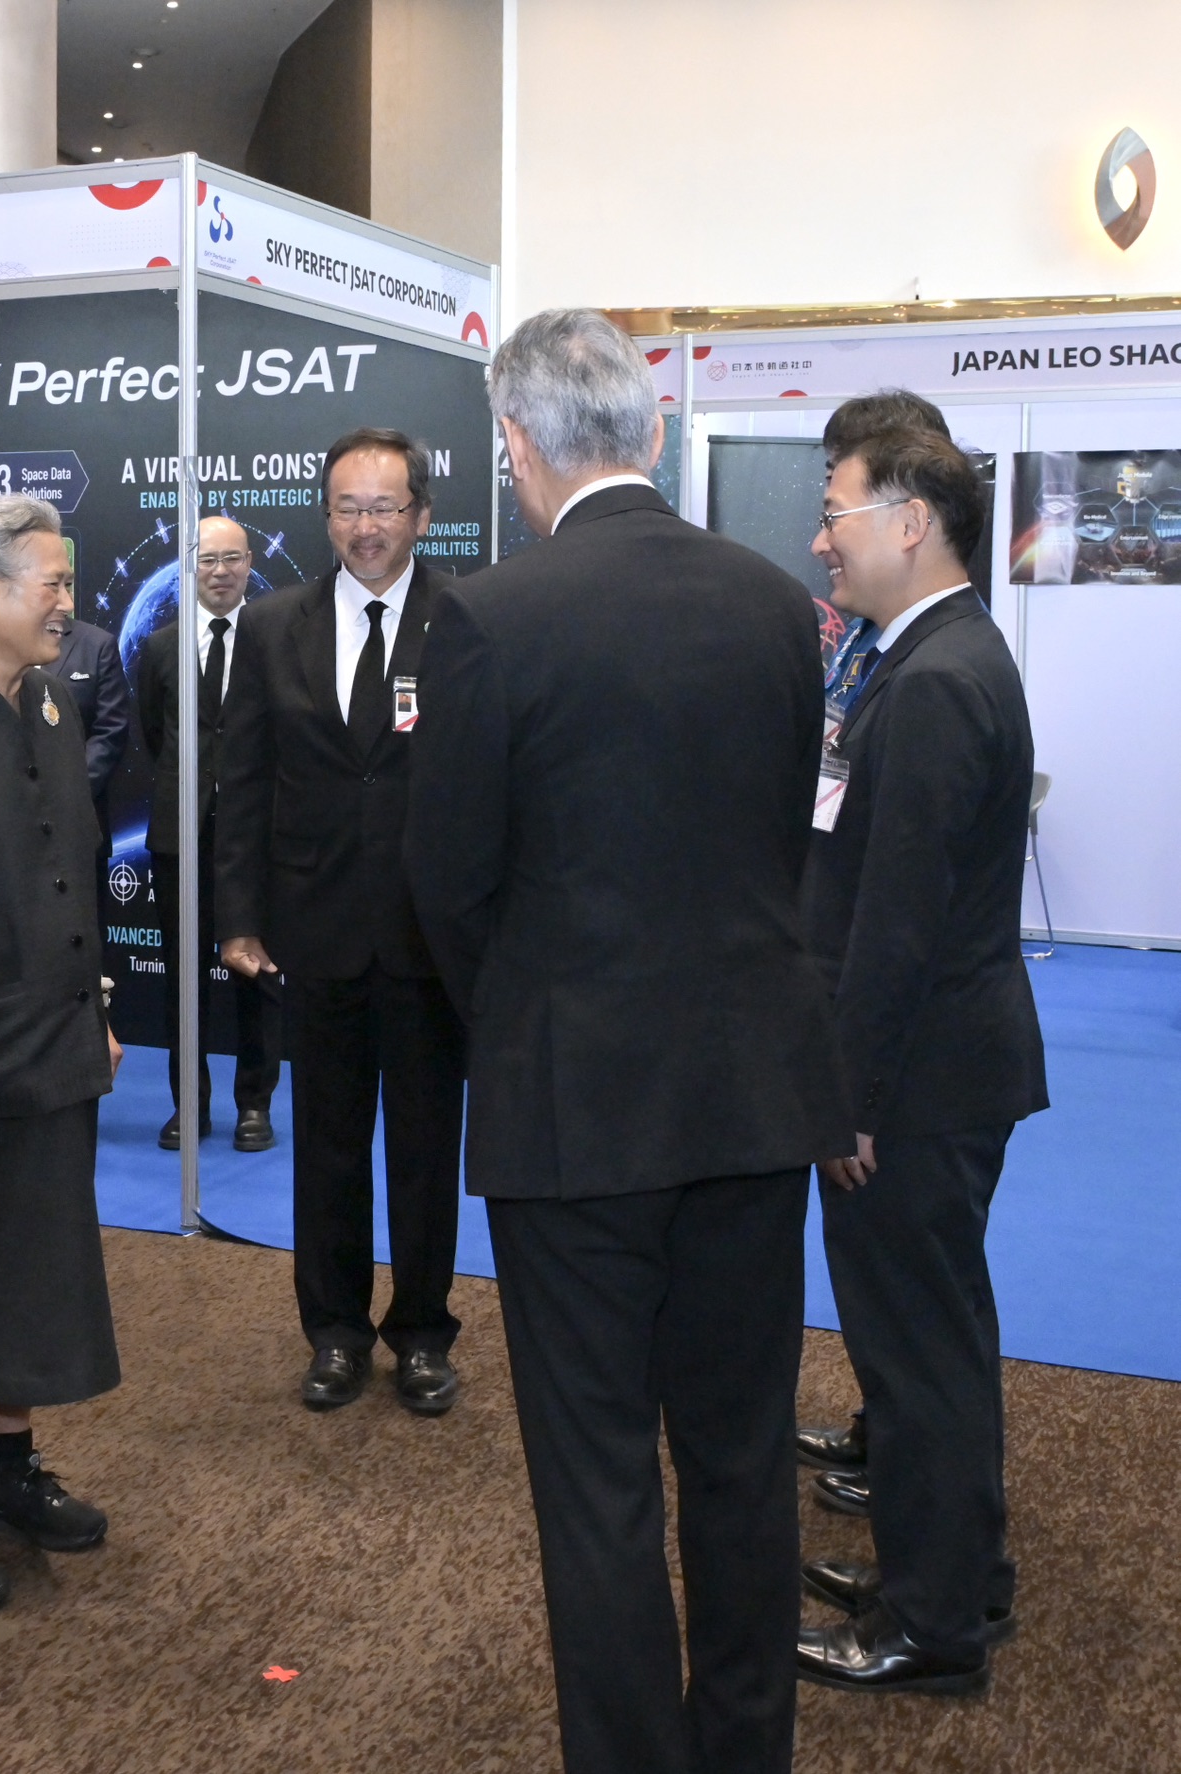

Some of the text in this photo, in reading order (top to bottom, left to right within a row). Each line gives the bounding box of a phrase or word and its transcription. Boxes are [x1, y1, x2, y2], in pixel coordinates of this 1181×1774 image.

[266, 238, 456, 317] SKY PERFECT JSAT CORPORATION
[951, 342, 1181, 377] JAPAN LEO SHAC
[8, 357, 204, 407] Perfec
[215, 344, 377, 397] JSAT
[21, 468, 71, 484] Space Data
[121, 458, 135, 484] A
[144, 455, 241, 483] VIRUAL
[22, 485, 63, 501] Solutions
[140, 489, 203, 509] ENAB
[208, 490, 228, 508] BY
[232, 488, 311, 507] STRATEGIC
[412, 541, 479, 556] PABILITIES
[107, 926, 162, 947] VANCED
[129, 955, 229, 981] Turnin nto
